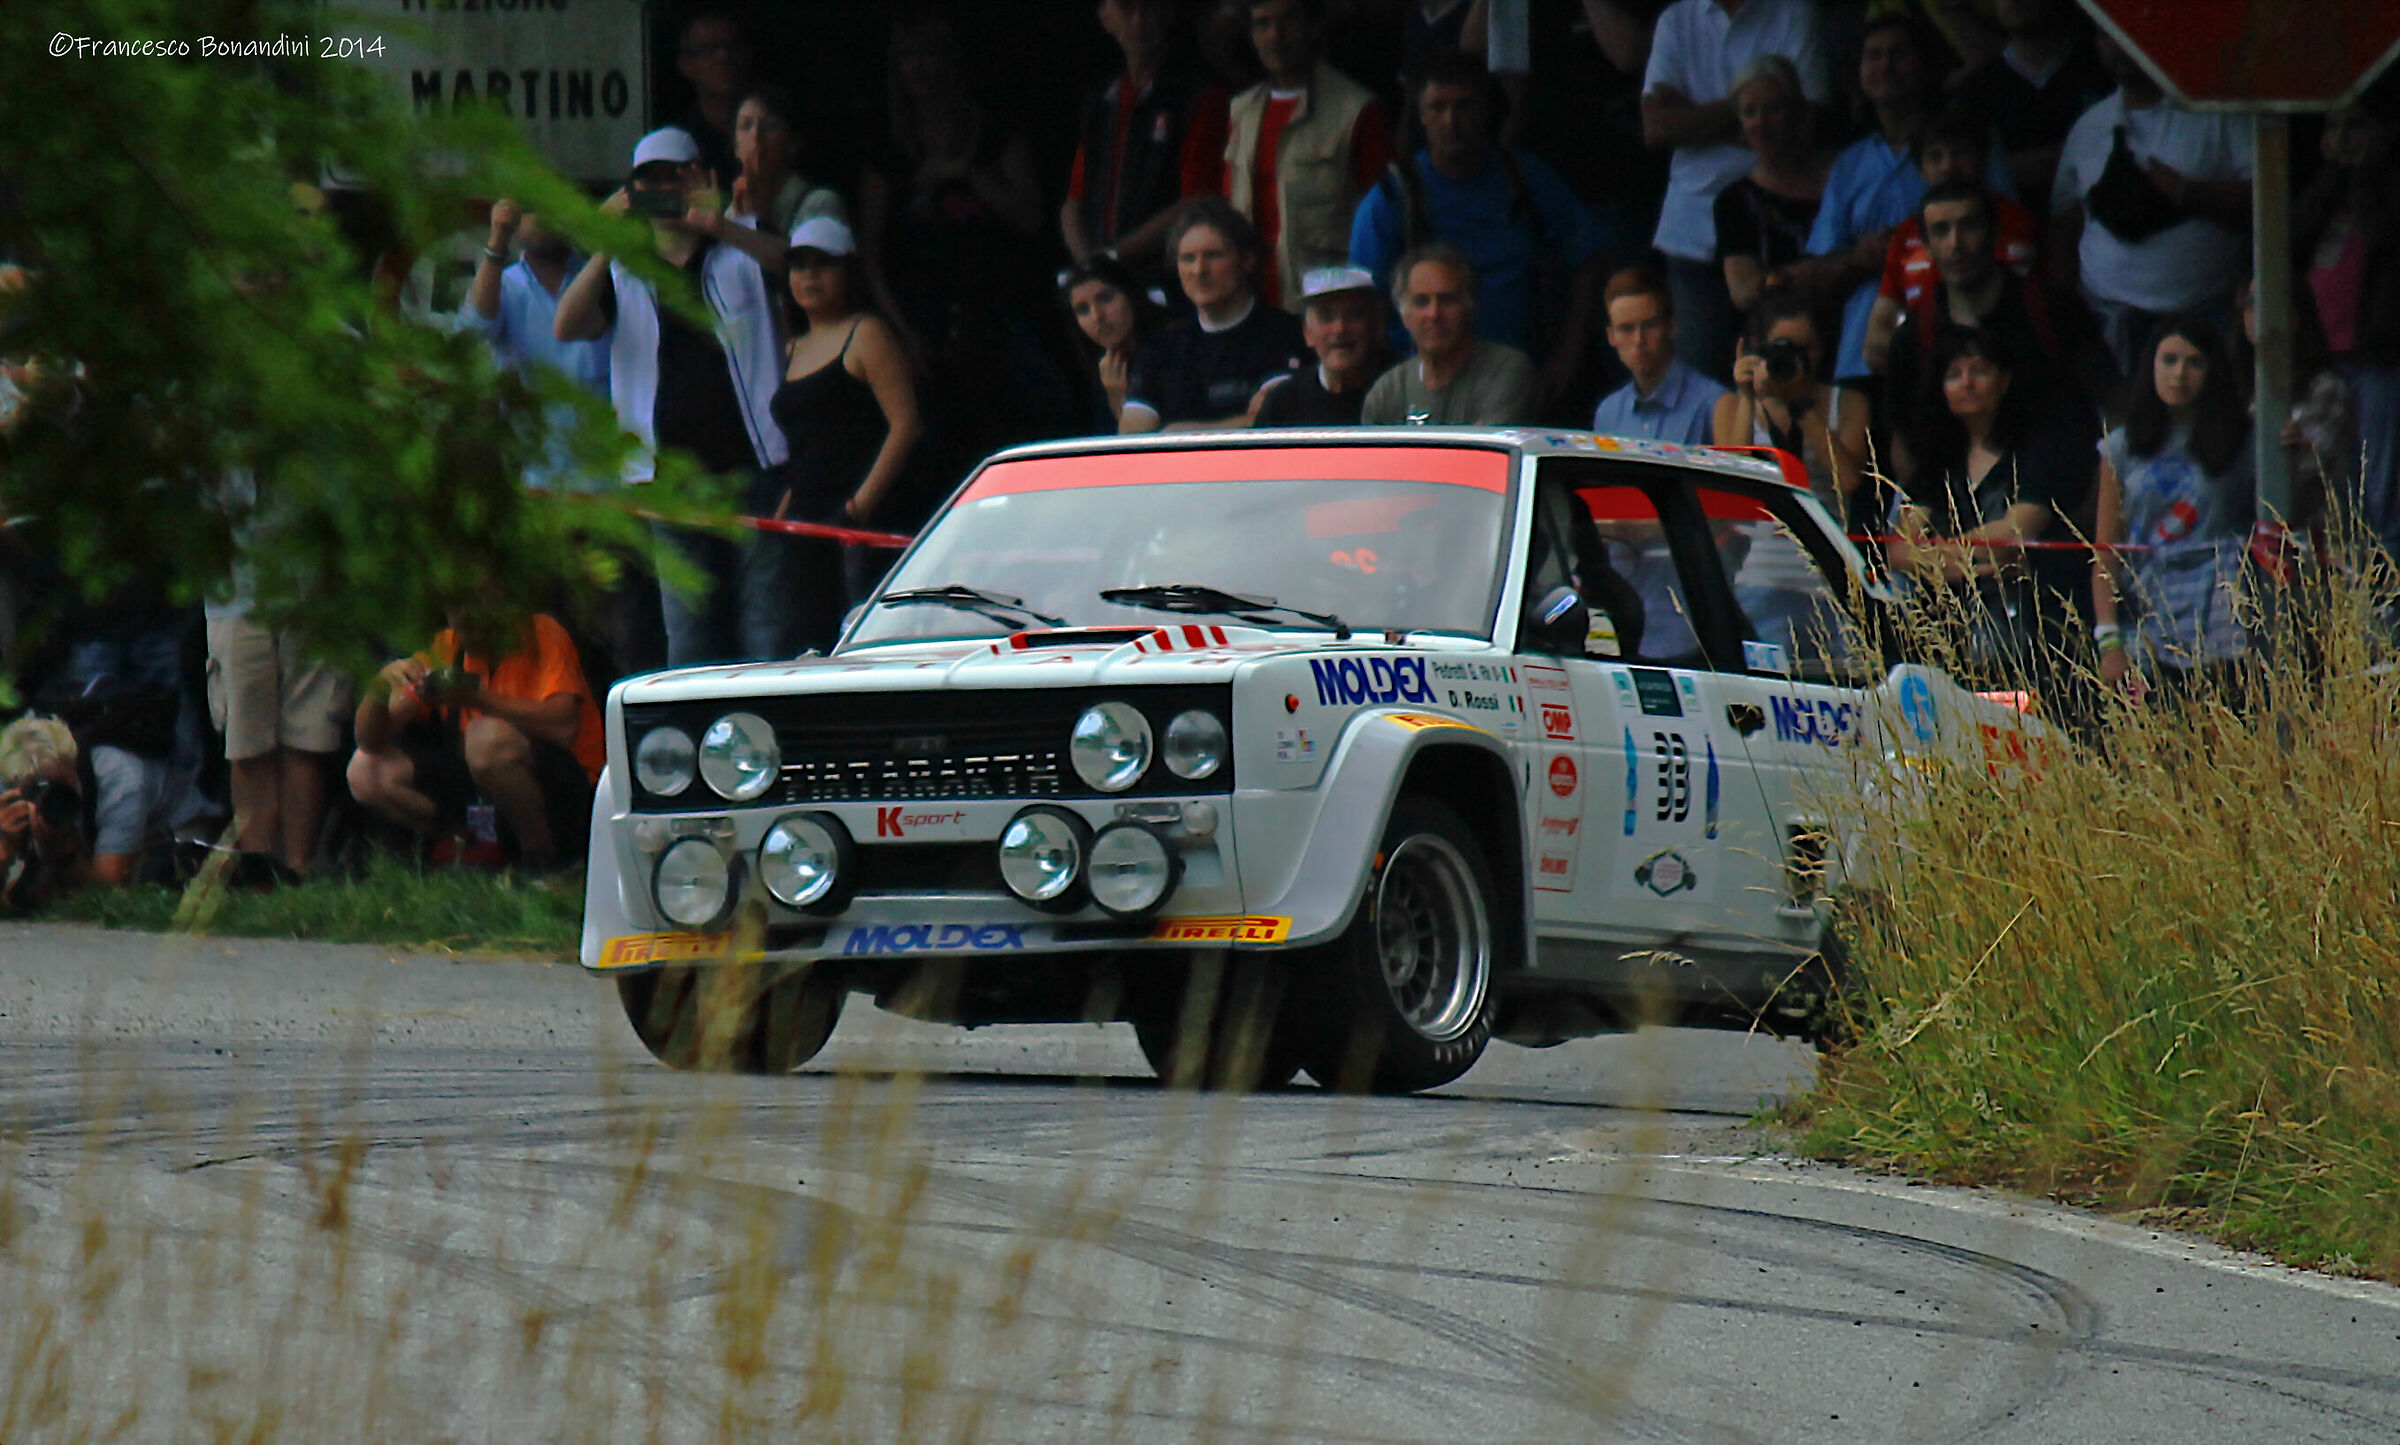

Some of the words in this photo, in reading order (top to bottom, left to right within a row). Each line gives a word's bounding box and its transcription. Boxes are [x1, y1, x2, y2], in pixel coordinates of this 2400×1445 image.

[411, 68, 629, 119] MARTINO
[1309, 656, 1437, 706] MOLDEX
[1448, 690, 1462, 708] D.
[1464, 690, 1499, 710] Rossi
[1654, 731, 1690, 823] 33
[842, 923, 1025, 956] MOLDEX
[1155, 917, 1280, 939] PIRELLI
